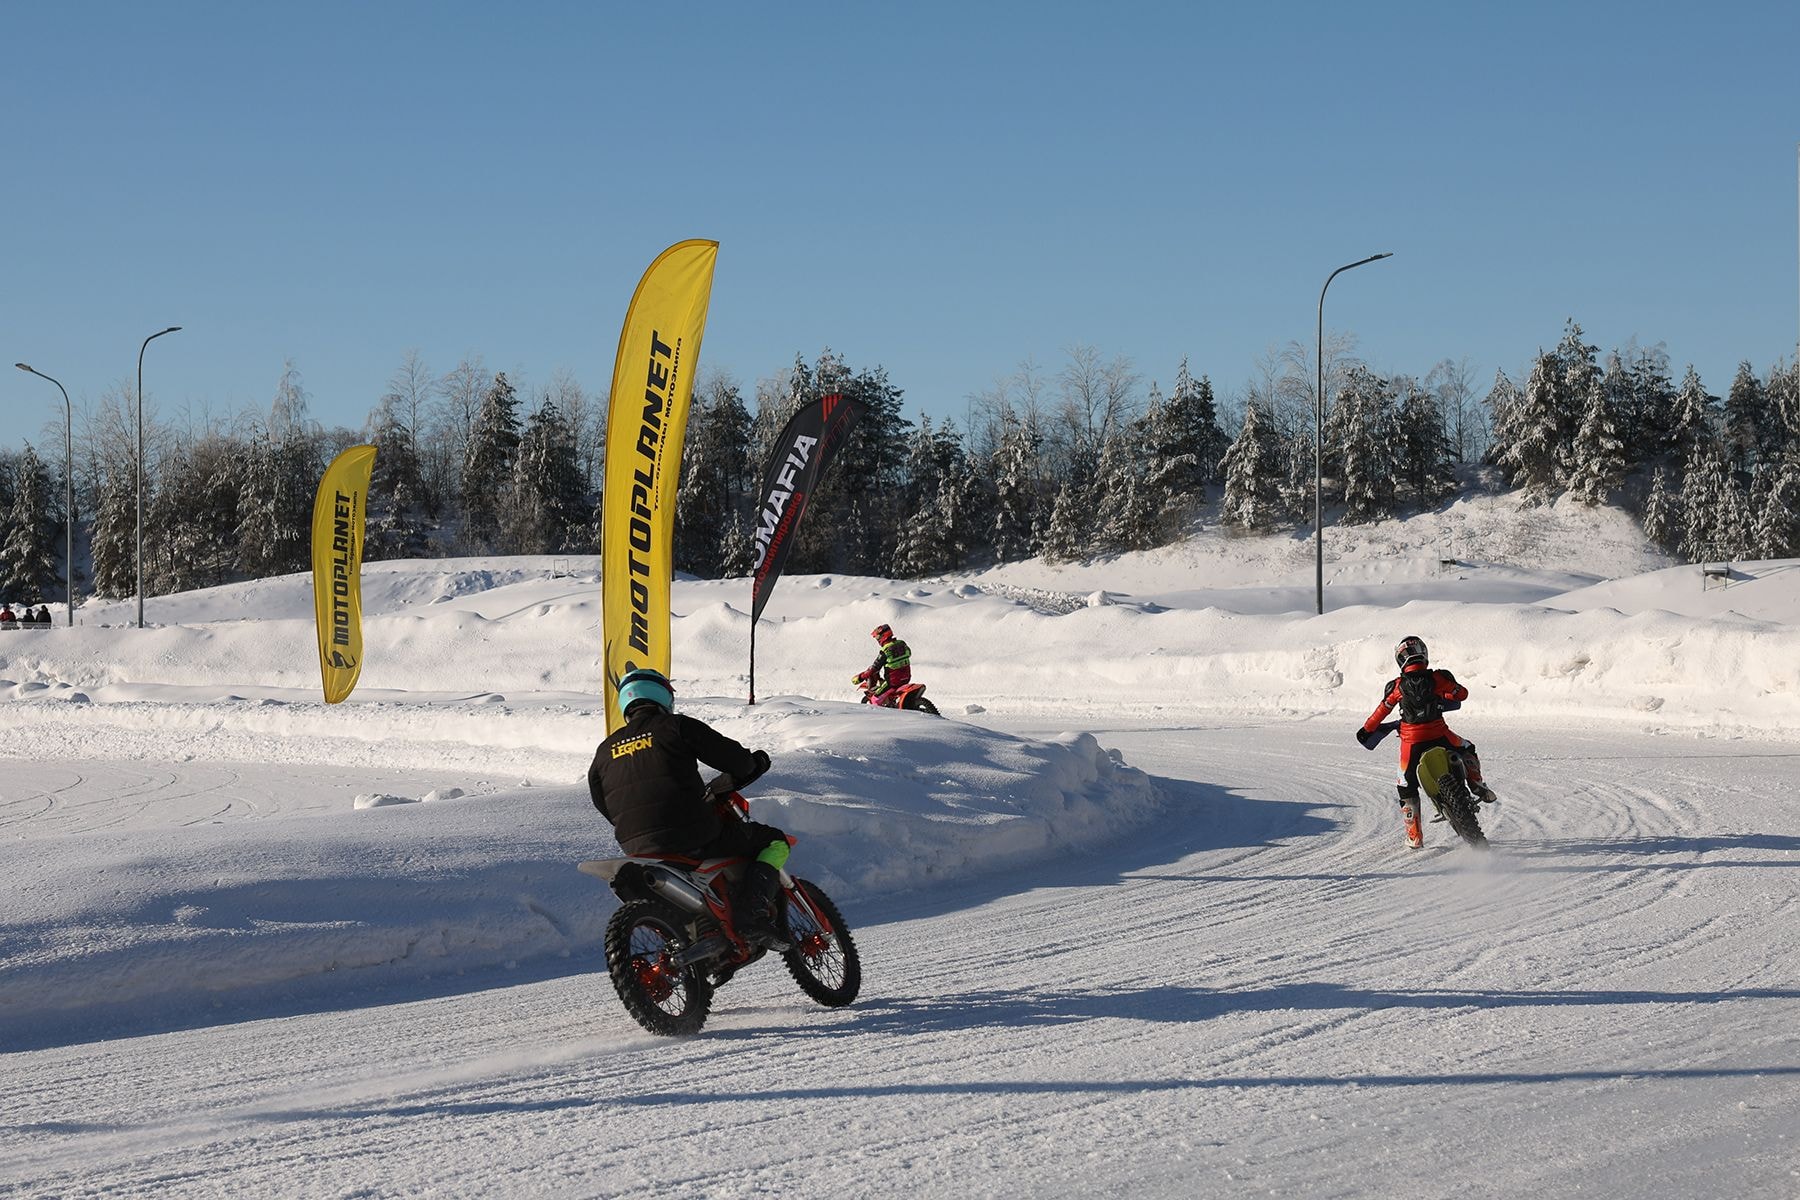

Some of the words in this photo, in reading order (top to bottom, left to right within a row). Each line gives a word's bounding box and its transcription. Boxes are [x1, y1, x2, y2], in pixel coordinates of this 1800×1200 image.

[332, 490, 351, 646] MOTOPLANET
[627, 330, 673, 656] MOTOPLANET
[611, 736, 654, 760] LEGION
